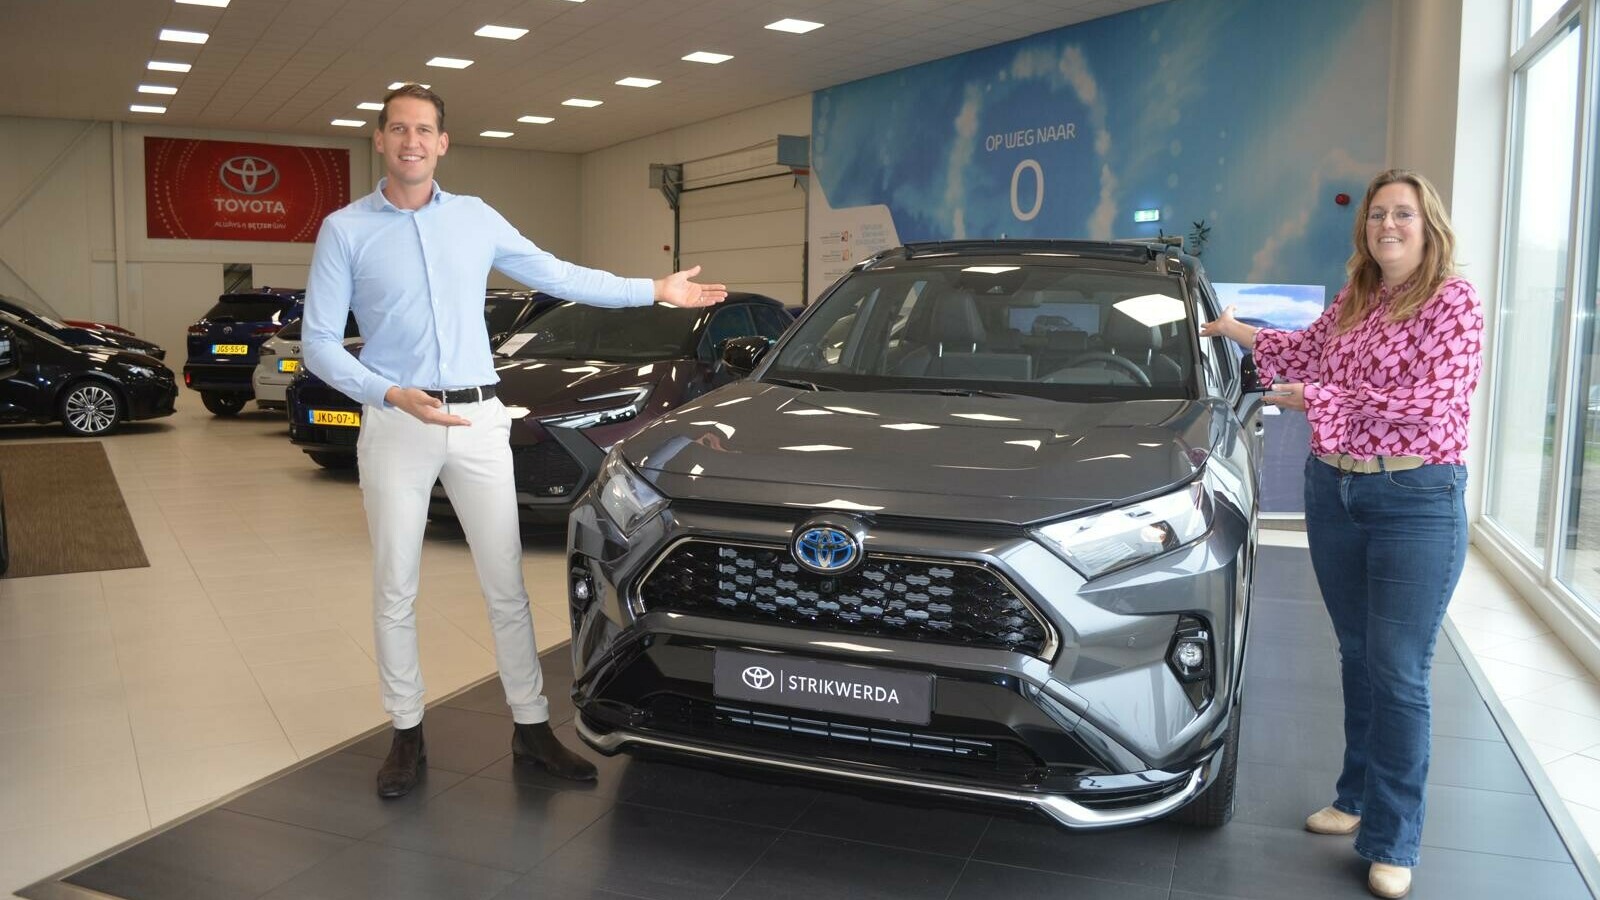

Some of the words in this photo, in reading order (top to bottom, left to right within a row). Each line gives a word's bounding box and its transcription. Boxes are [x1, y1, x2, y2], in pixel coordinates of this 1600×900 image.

[985, 134, 1003, 152] OP
[1005, 129, 1035, 149] WEG
[1037, 122, 1076, 143] NAAR
[214, 198, 286, 214] TOYOTA
[316, 412, 356, 424] JKD-07-J
[788, 675, 900, 704] STRIKWERDA
